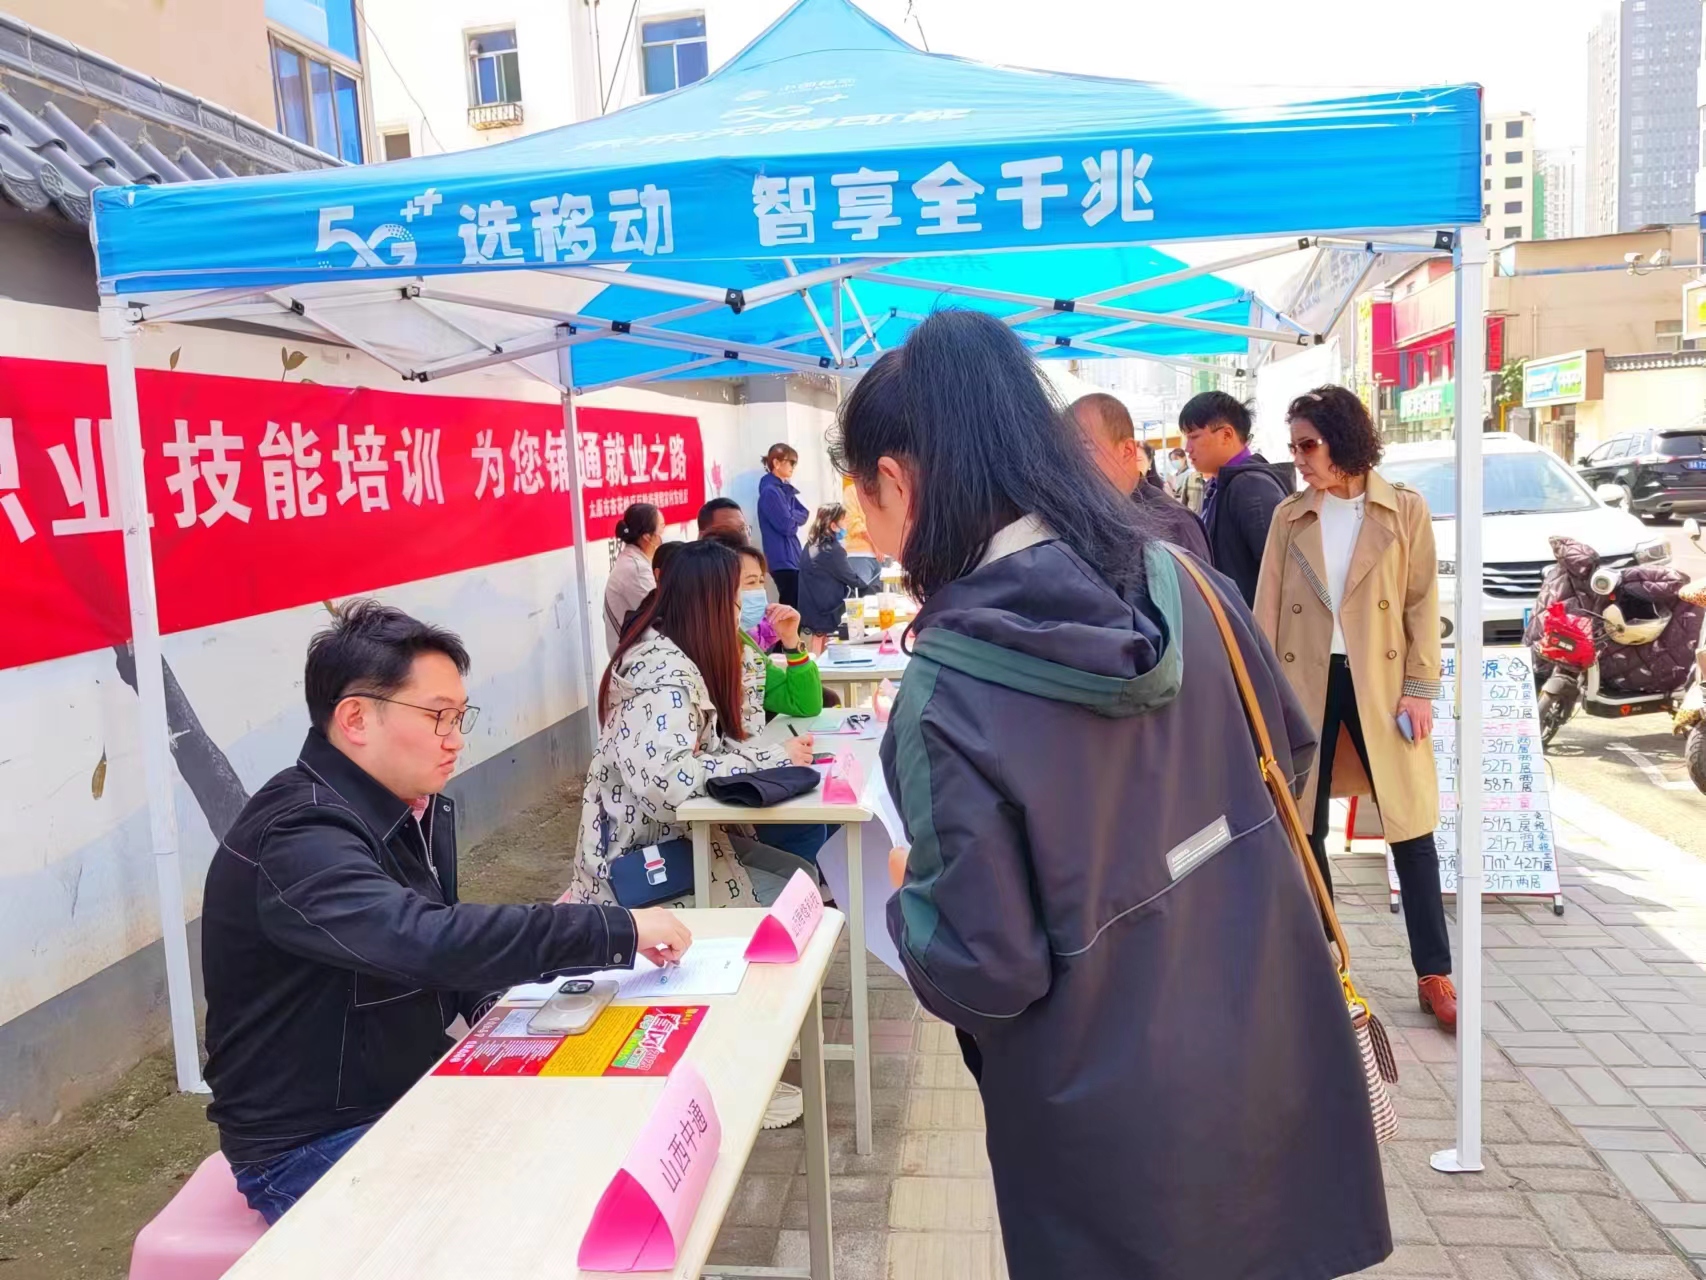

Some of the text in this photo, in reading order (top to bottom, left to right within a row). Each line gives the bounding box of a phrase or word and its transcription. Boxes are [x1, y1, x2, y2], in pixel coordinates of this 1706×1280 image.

[458, 184, 673, 264] 选移动
[752, 148, 1154, 247] 智享全千兆
[472, 429, 687, 500] 为您铺通就业之路
[1484, 777, 1513, 792] 58万
[1484, 874, 1512, 889] 39万
[1515, 874, 1541, 889] 两居
[1514, 855, 1543, 870] 42万
[659, 1098, 708, 1193] 山西中通
